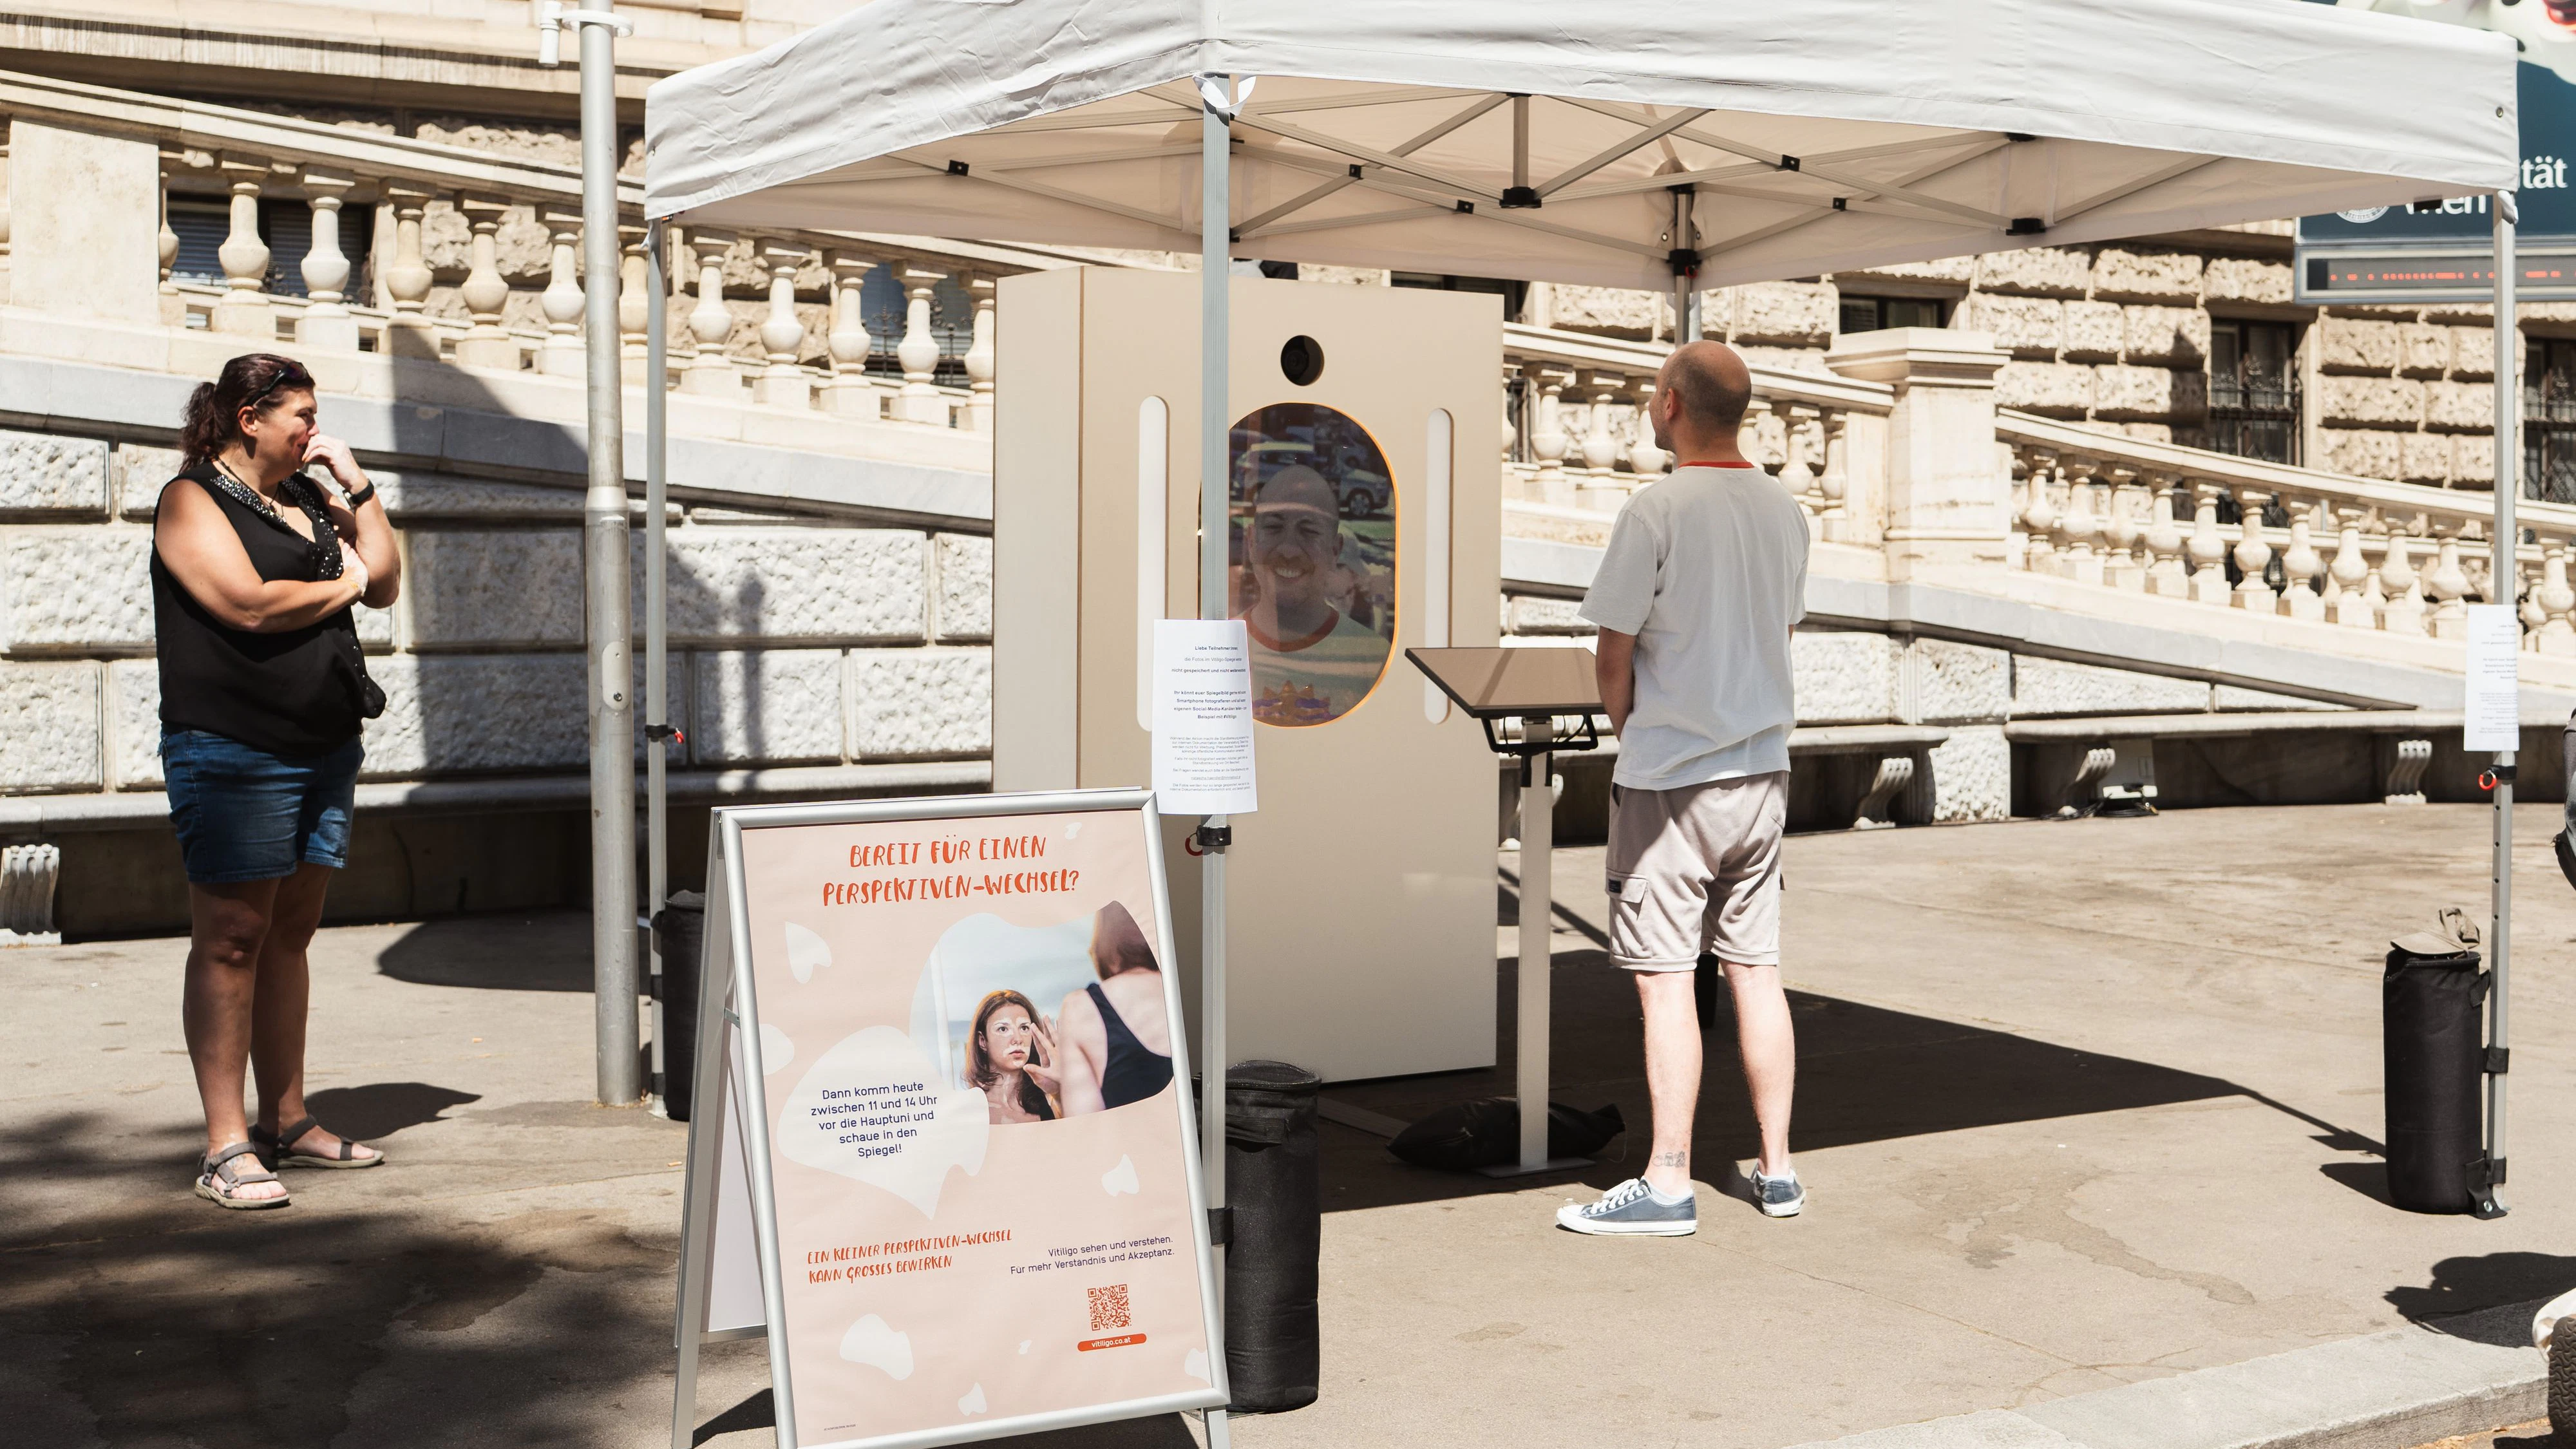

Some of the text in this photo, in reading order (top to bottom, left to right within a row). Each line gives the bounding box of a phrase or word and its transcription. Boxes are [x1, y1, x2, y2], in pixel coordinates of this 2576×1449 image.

[849, 834, 1046, 868] BEREIT FÜR EINEN
[822, 868, 1079, 907] PERSPEKTIVEN-WECHSEL?
[822, 1081, 923, 1100] Dann komm heute
[810, 1095, 938, 1116] zwischen 11 und 14 Uhr
[818, 1110, 934, 1131] vor die Hauptuni und
[839, 1128, 918, 1144] schaue in den
[858, 1143, 902, 1159] Spiegel!
[807, 1229, 1012, 1265] EIN KLEINER PERSPEKTIVEN-WECHSEL
[1048, 1236, 1173, 1257] Vitiligo sehen und verstehen.
[809, 1255, 952, 1284] KANN GROSSES BEWIRKEN
[1028, 1262, 1052, 1273] mehr
[1108, 1253, 1126, 1262] und
[1128, 1248, 1175, 1260] Akzeptanz.
[1091, 1336, 1132, 1349] vitiligo.co.at
